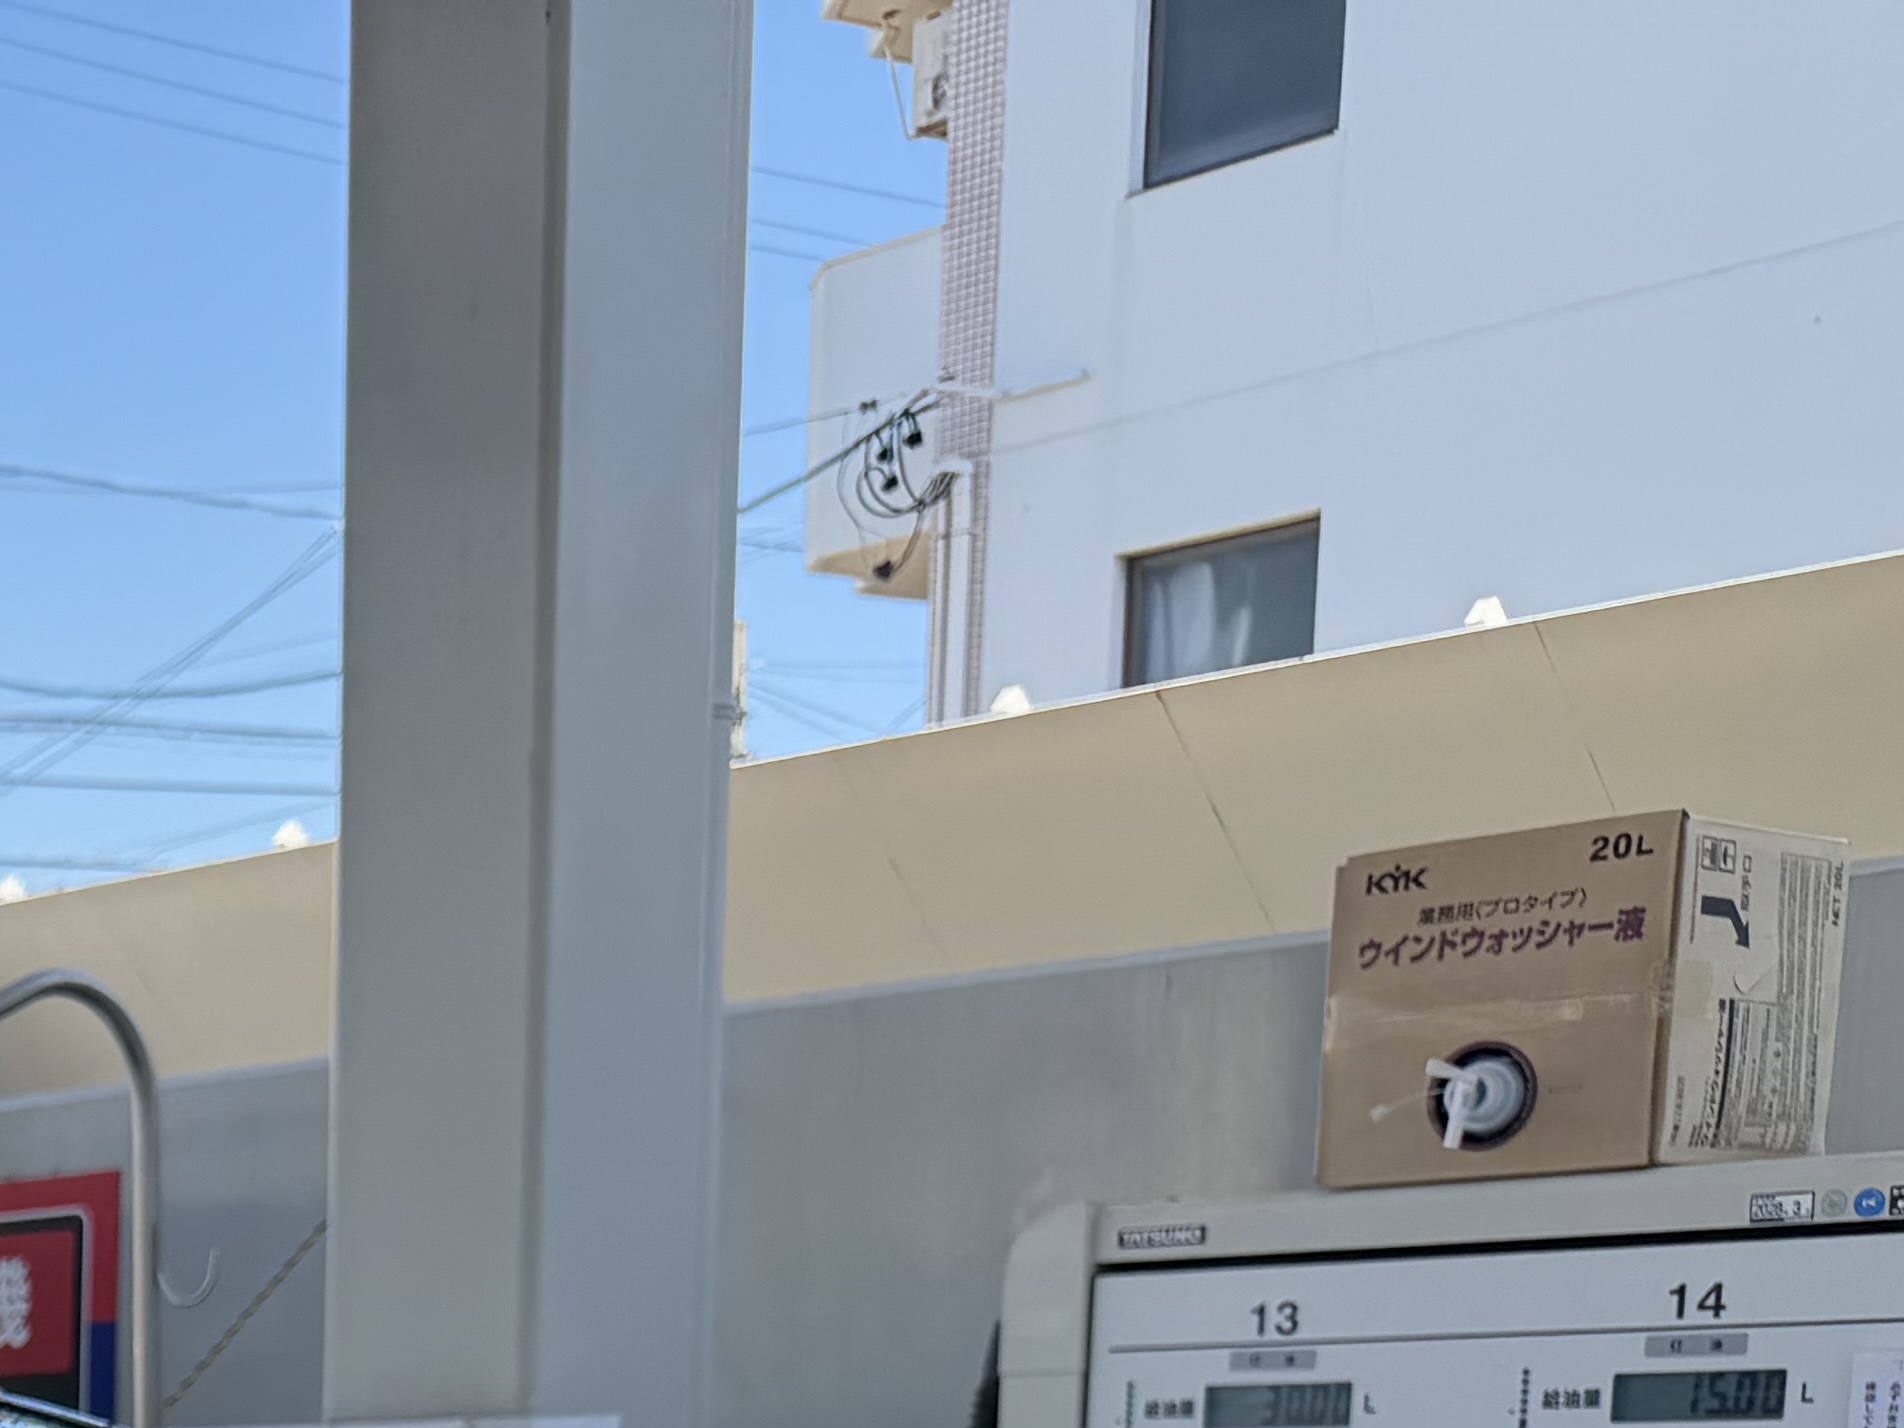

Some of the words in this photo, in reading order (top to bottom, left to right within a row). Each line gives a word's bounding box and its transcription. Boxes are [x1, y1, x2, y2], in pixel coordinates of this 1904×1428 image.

[1365, 864, 1428, 895] KYK
[1589, 832, 1654, 863] 20L
[1358, 905, 1646, 970] ウインドウォッシャー液
[1249, 1300, 1300, 1338] 13
[1668, 1281, 1727, 1319] 14
[1800, 1381, 1815, 1404] L
